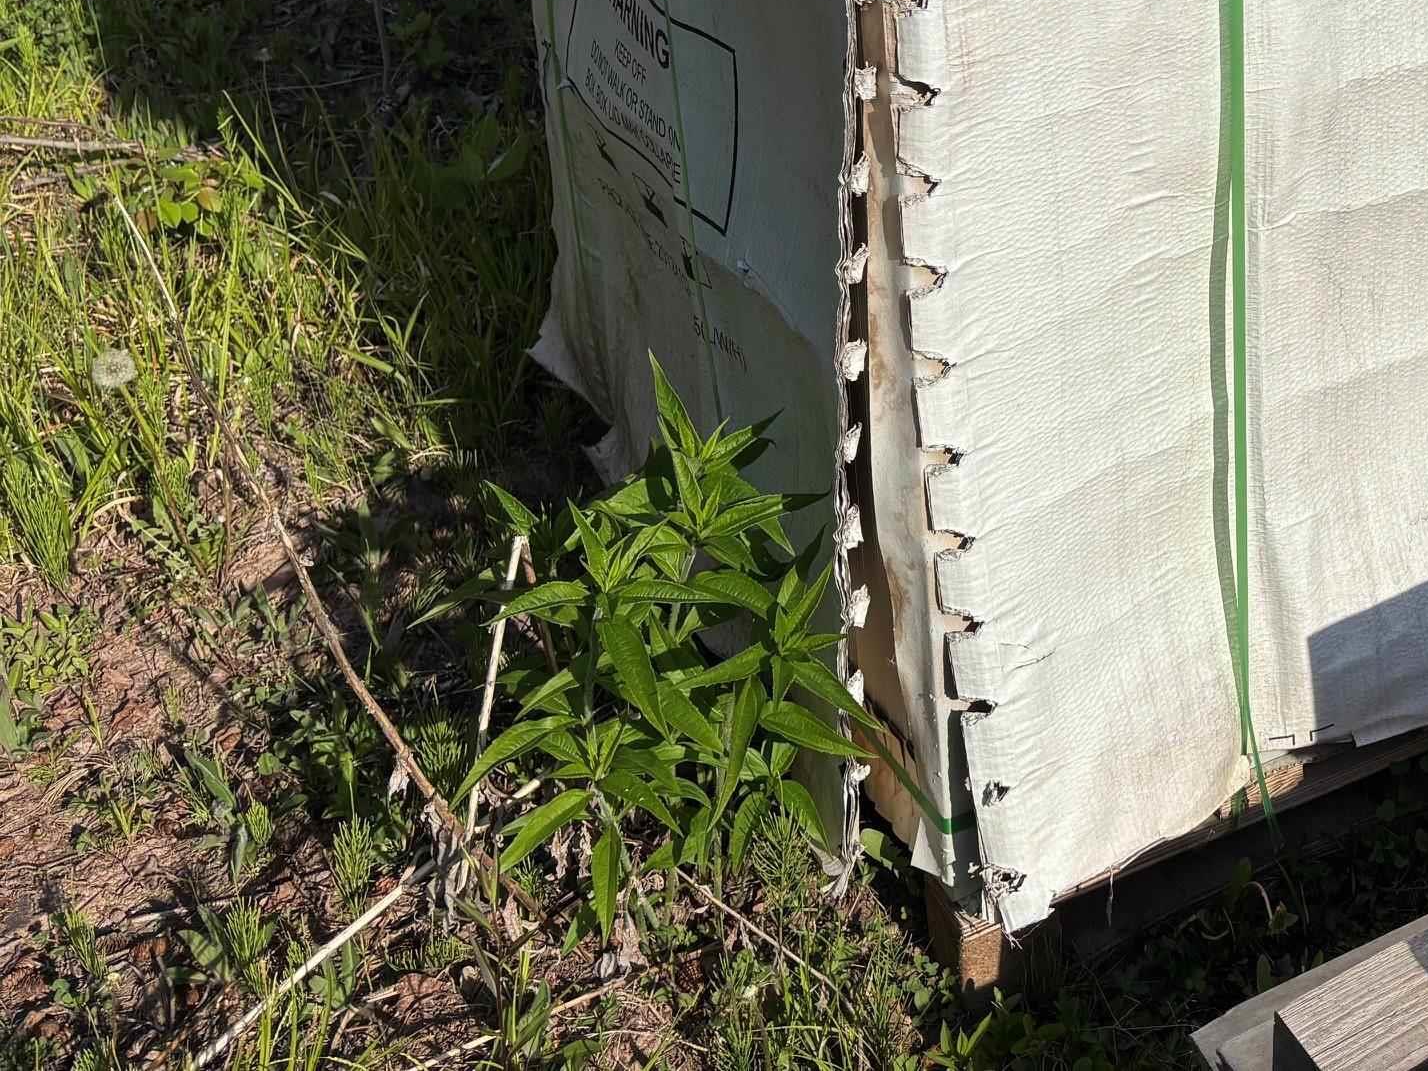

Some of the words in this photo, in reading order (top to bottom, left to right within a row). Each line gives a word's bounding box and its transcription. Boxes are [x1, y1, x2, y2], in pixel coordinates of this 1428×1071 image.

[615, 38, 632, 68] KEEP
[631, 57, 647, 85] OFF
[607, 64, 626, 100] WALK
[625, 87, 639, 113] OR
[639, 99, 666, 138] STAND
